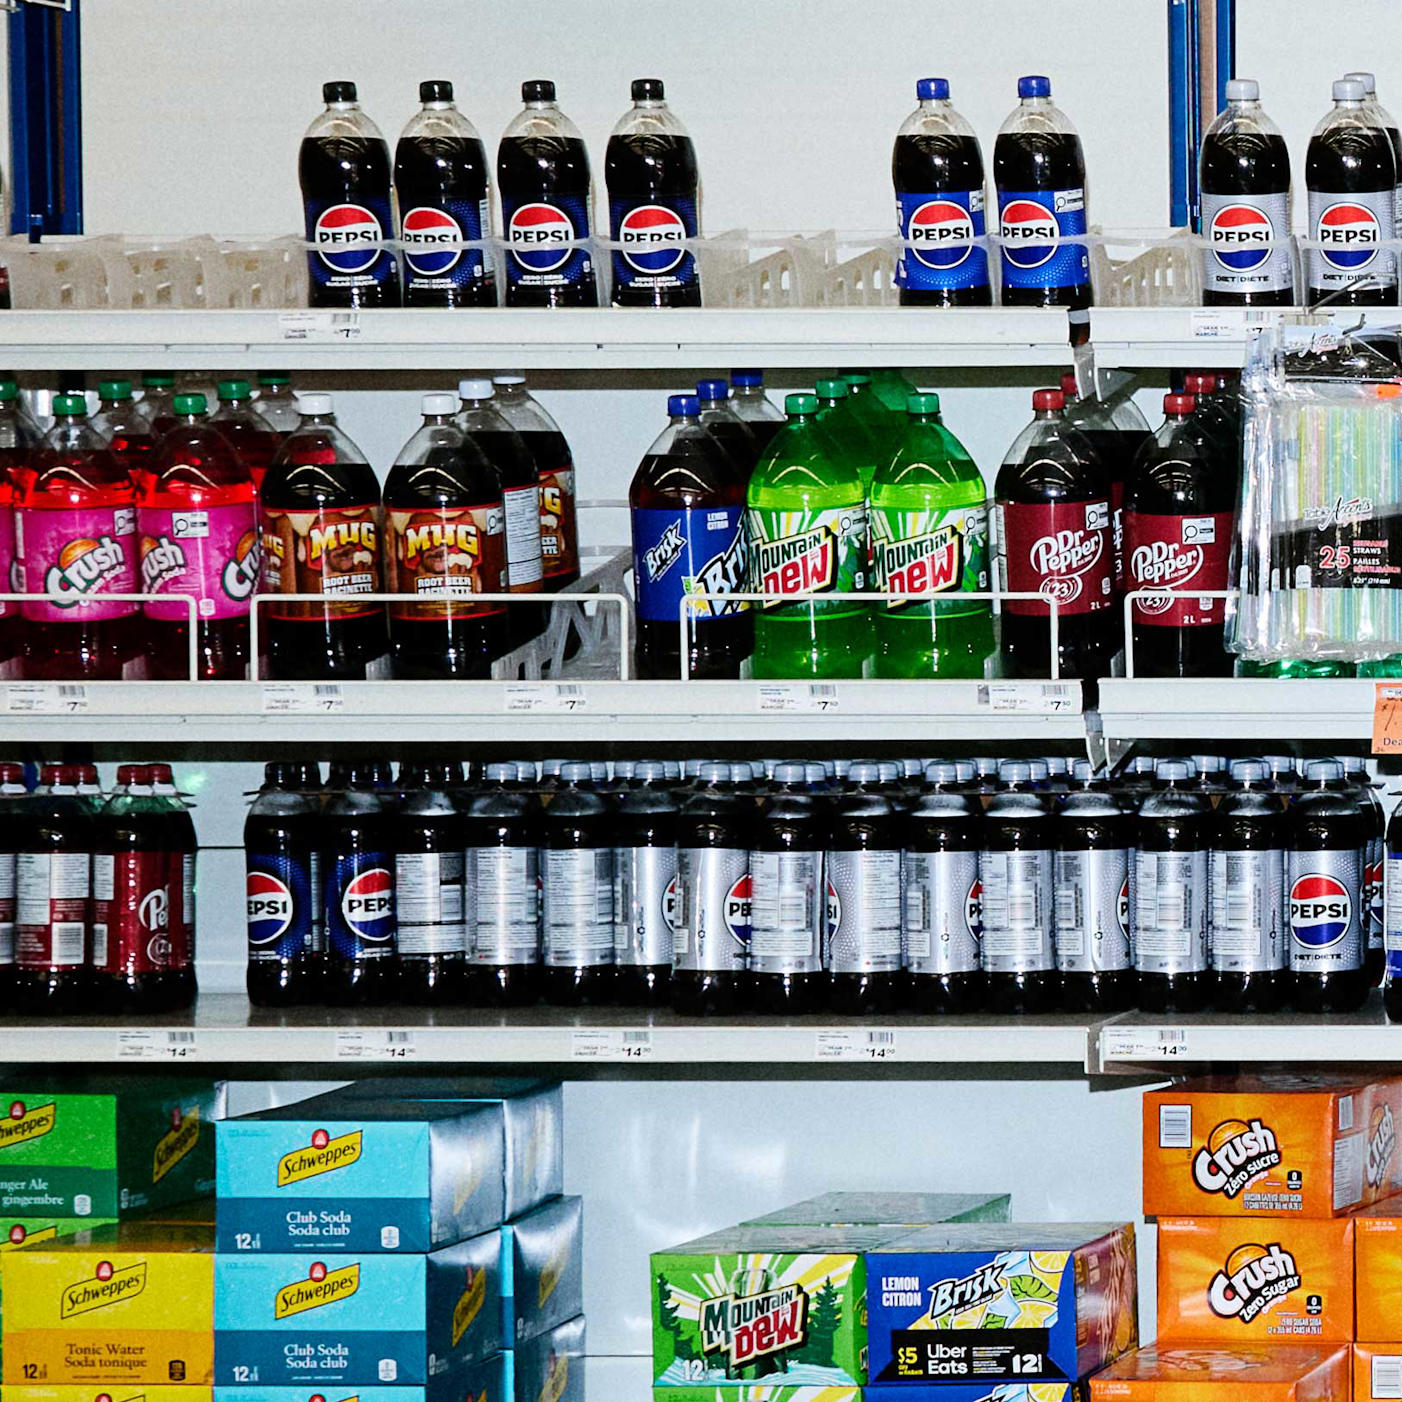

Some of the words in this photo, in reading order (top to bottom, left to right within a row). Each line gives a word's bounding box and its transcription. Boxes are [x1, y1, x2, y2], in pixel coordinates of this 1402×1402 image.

[310, 522, 376, 561] MUG
[407, 525, 479, 558] MUG
[1291, 903, 1348, 920] PEPSI
[283, 1142, 358, 1179] Schweppes
[1195, 1120, 1276, 1190] Crush
[1247, 1152, 1280, 1175] sucre
[286, 1211, 316, 1224] Club
[320, 1211, 351, 1224] Soda
[288, 1223, 318, 1236] Soda
[322, 1222, 350, 1236] club
[881, 1276, 919, 1291] LEMON
[1210, 1245, 1296, 1316] Crush
[67, 1274, 142, 1311] Schweppes
[281, 1274, 355, 1310] Schweppes
[881, 1292, 922, 1307] CITRON
[931, 1267, 1001, 1319] Brisk
[1239, 1296, 1265, 1321] Zero
[1261, 1276, 1300, 1301] Sugar
[65, 1344, 104, 1356] Tonic
[107, 1343, 145, 1356] Water
[898, 1347, 918, 1364] $5
[927, 1344, 968, 1359] Uber
[64, 1356, 95, 1368] Soda
[98, 1356, 149, 1371] tonique
[927, 1360, 968, 1375] Eats
[1012, 1353, 1038, 1373] 12
